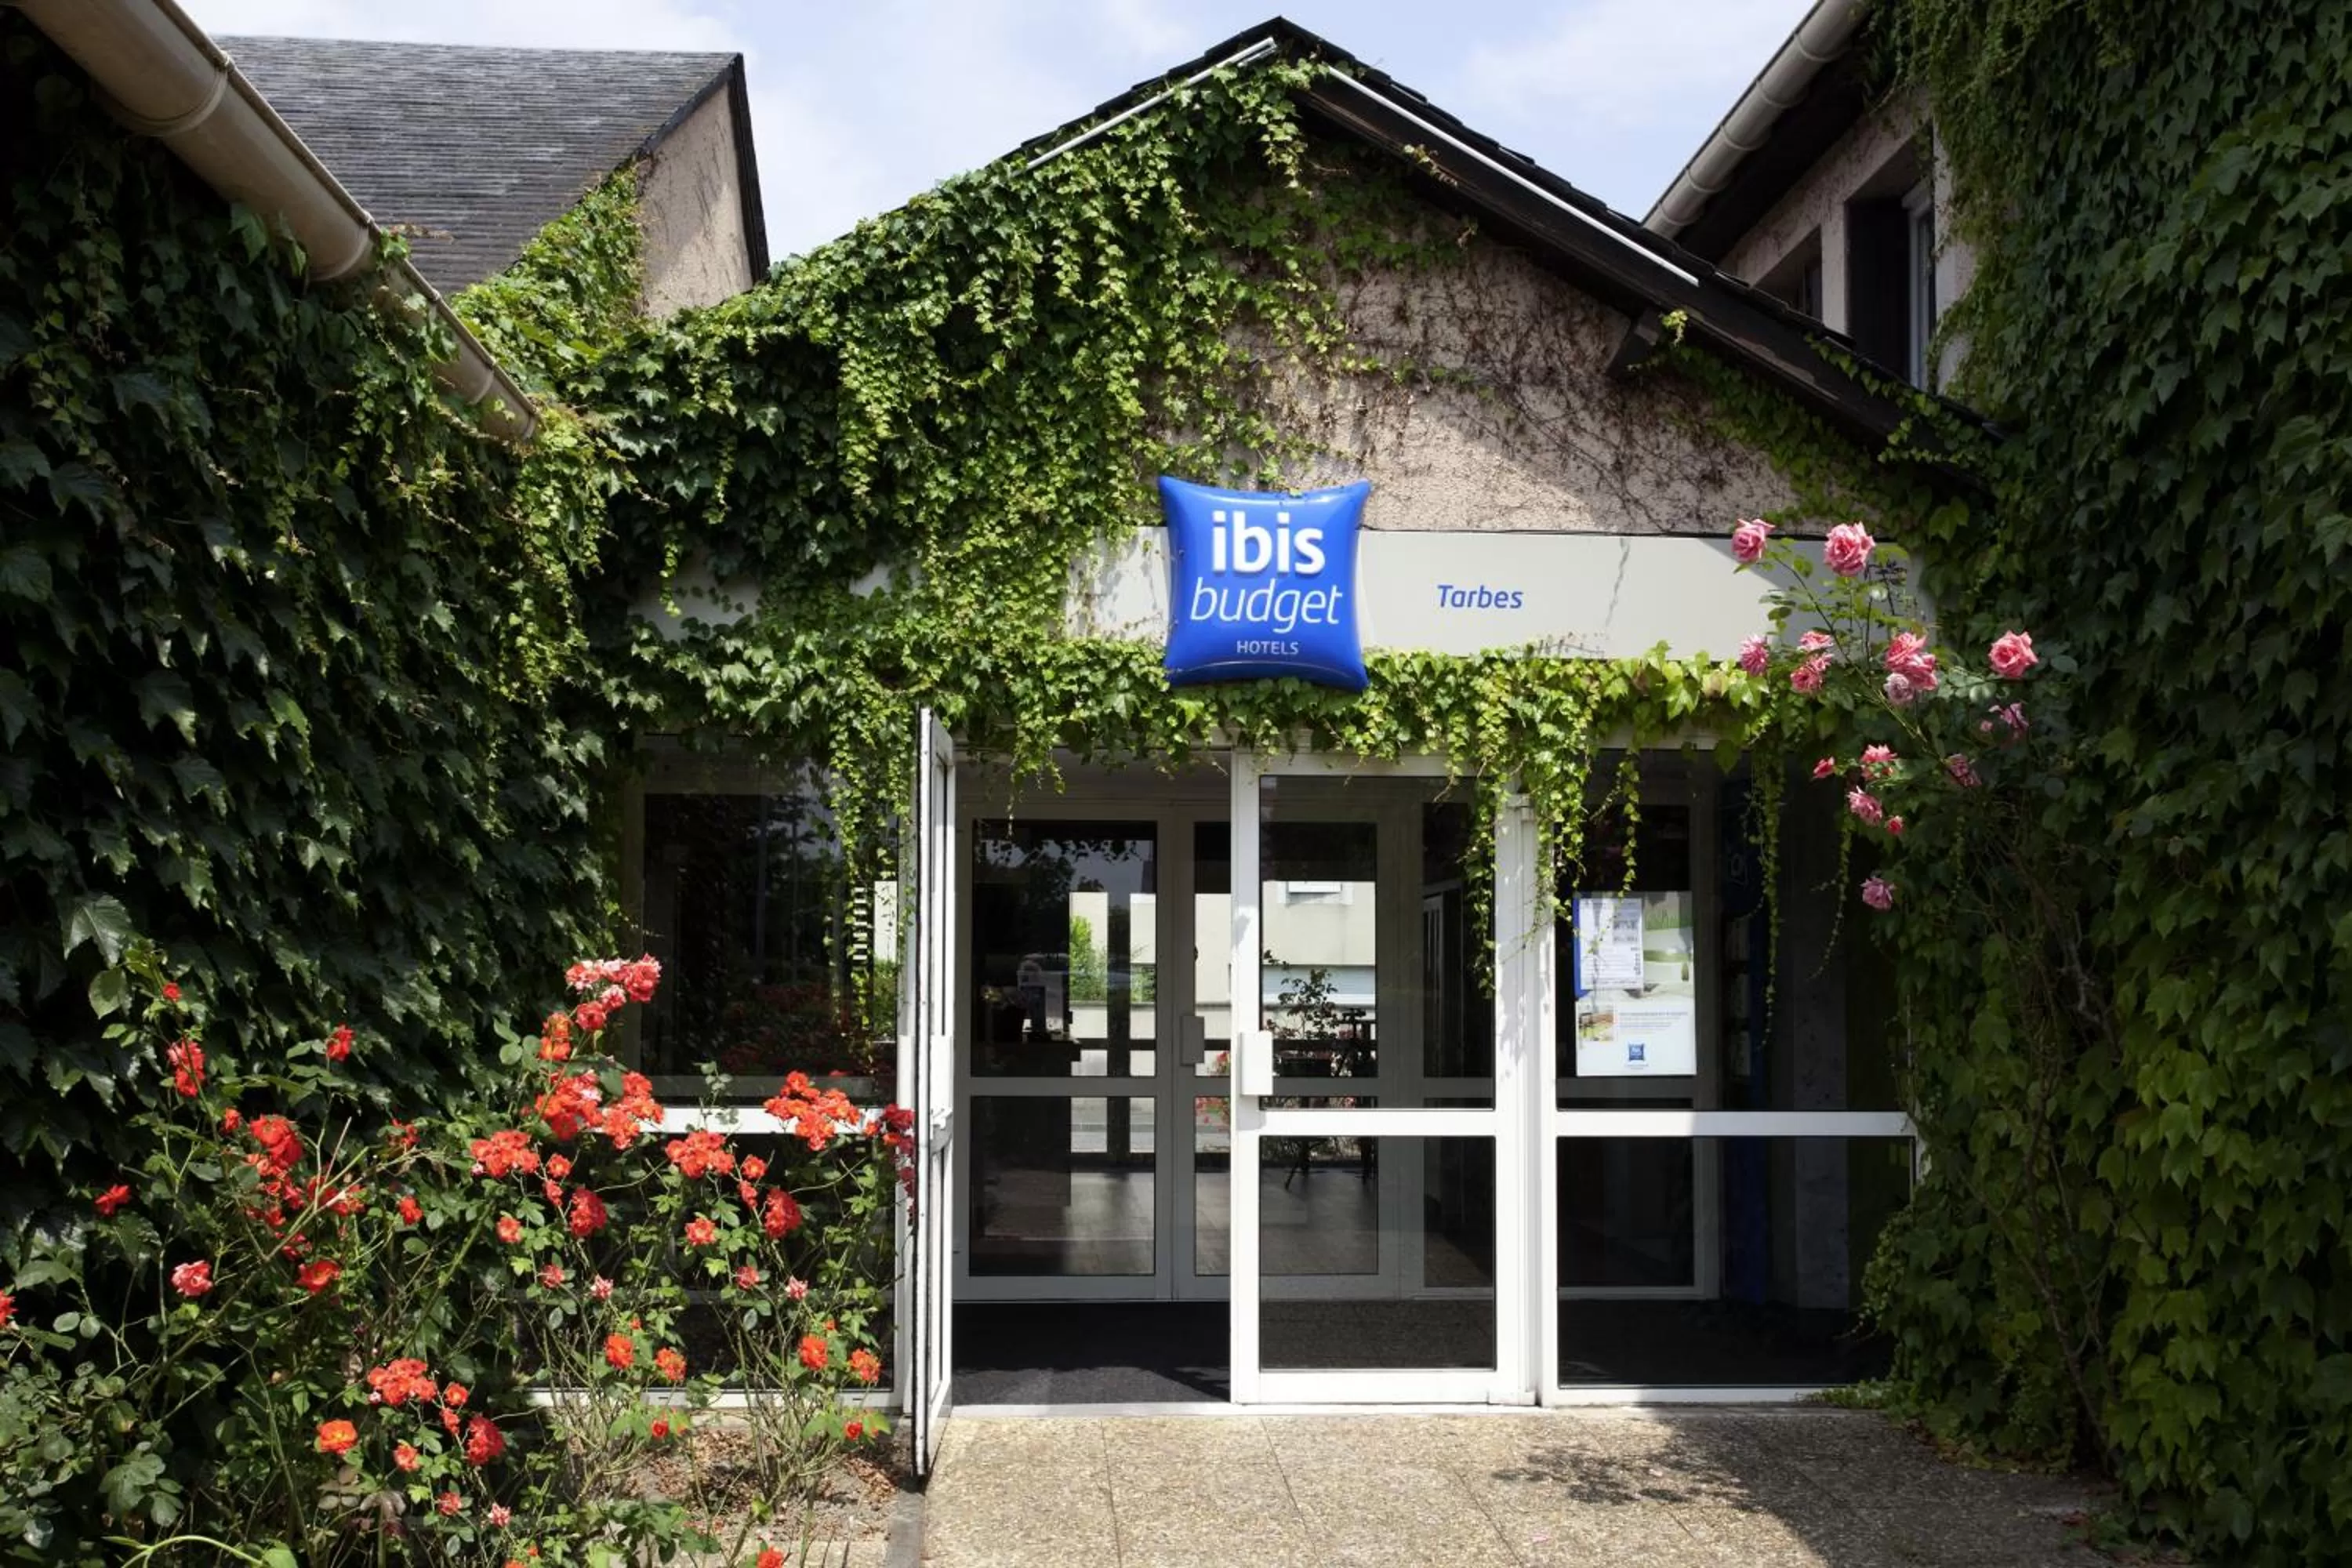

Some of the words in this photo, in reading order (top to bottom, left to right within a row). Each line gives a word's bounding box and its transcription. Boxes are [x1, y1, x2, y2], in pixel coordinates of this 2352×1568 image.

[1211, 510, 1327, 575] ibis
[1189, 576, 1344, 634] budget
[1437, 584, 1524, 609] Tarbes
[1236, 641, 1299, 655] HOTELS
